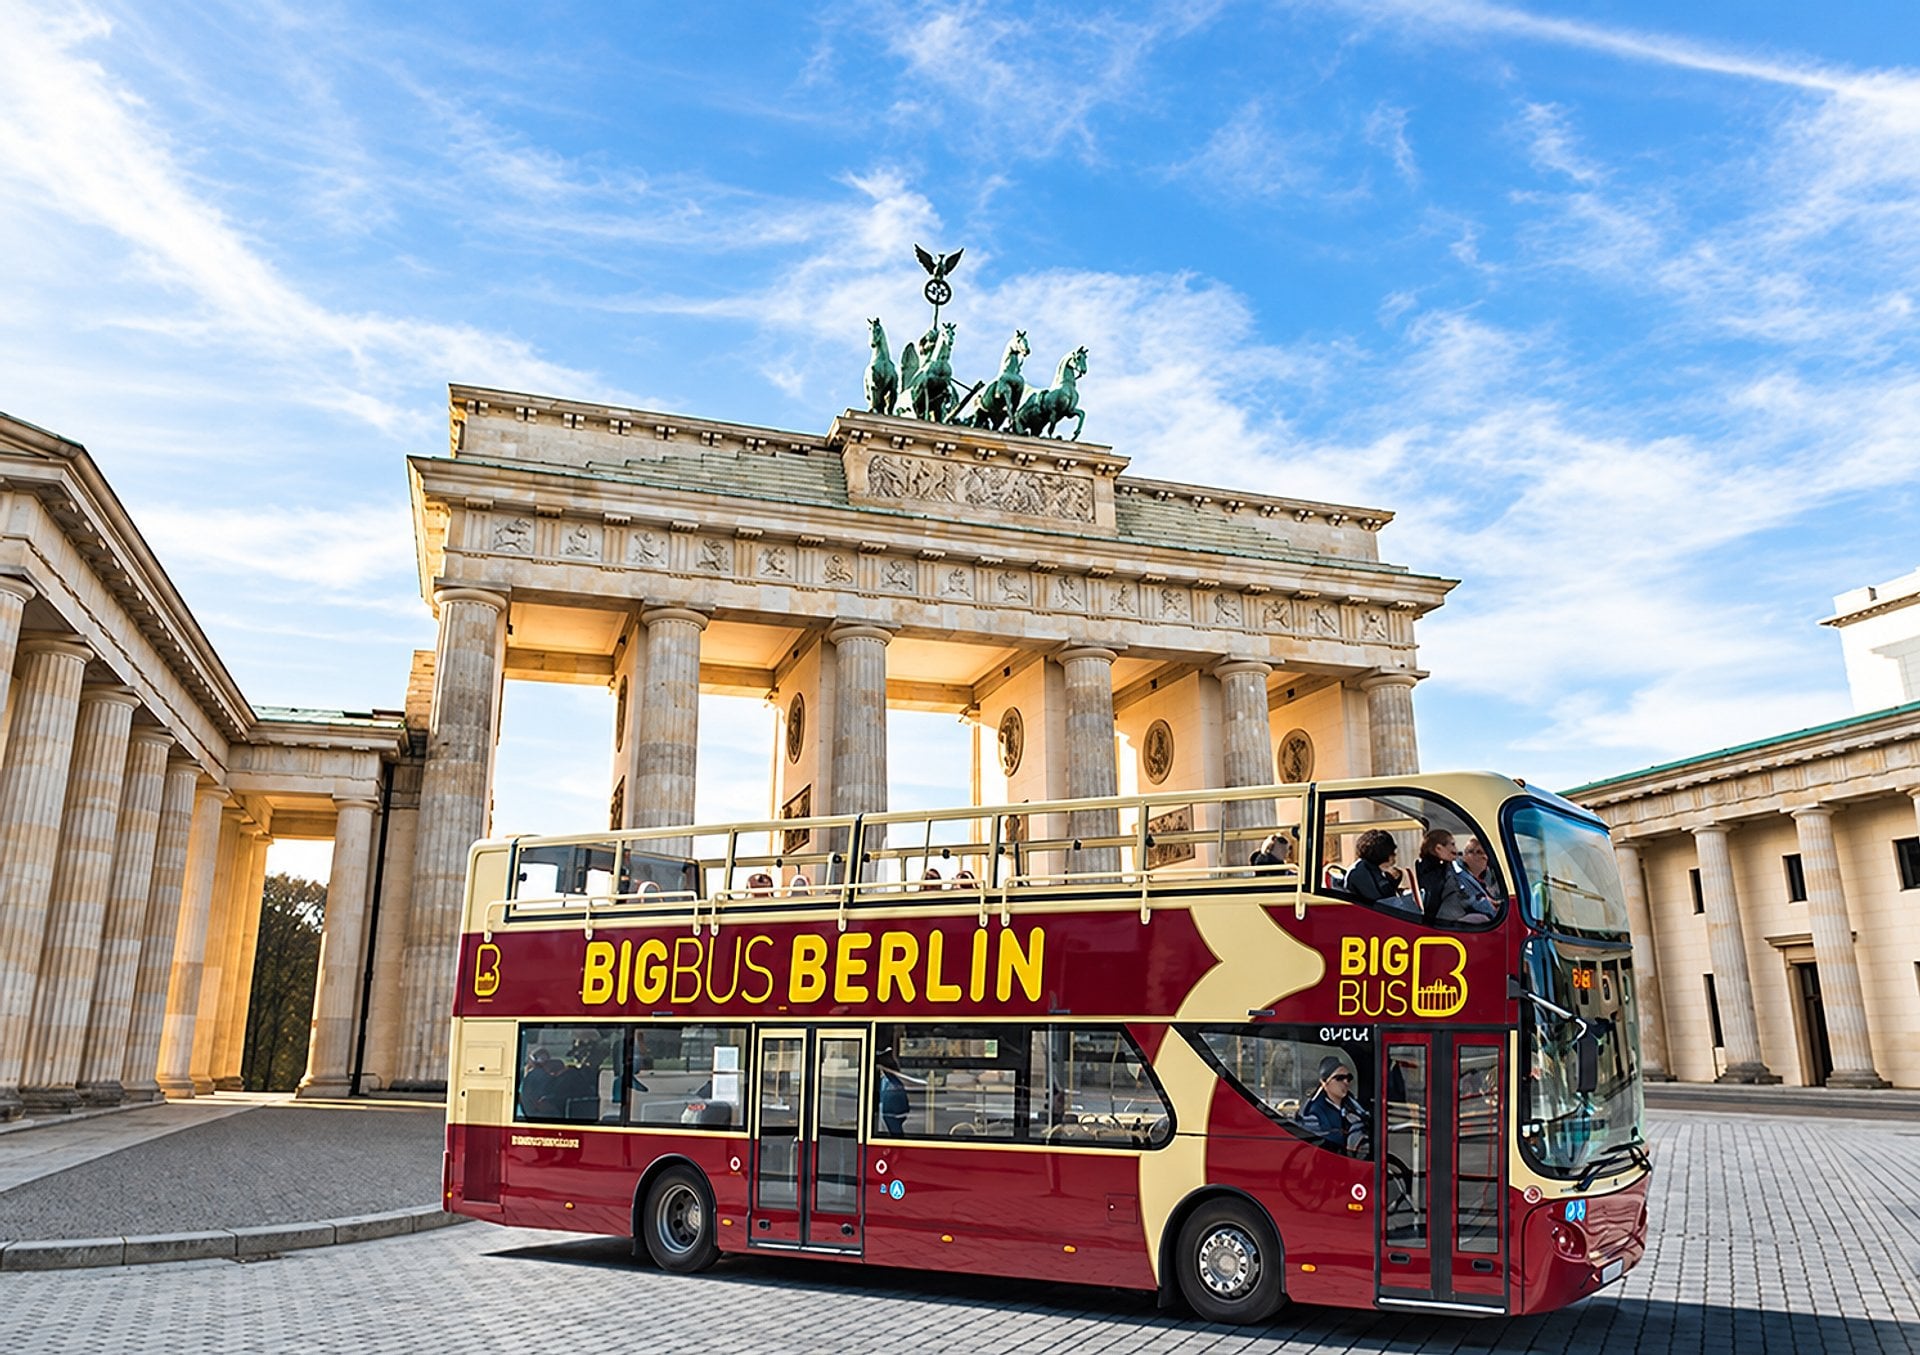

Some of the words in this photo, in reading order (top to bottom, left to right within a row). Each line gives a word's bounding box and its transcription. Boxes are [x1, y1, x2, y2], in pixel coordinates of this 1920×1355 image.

[788, 927, 1045, 1003] BERLIN
[1340, 936, 1409, 976] BIG
[1339, 980, 1408, 1016] BUS
